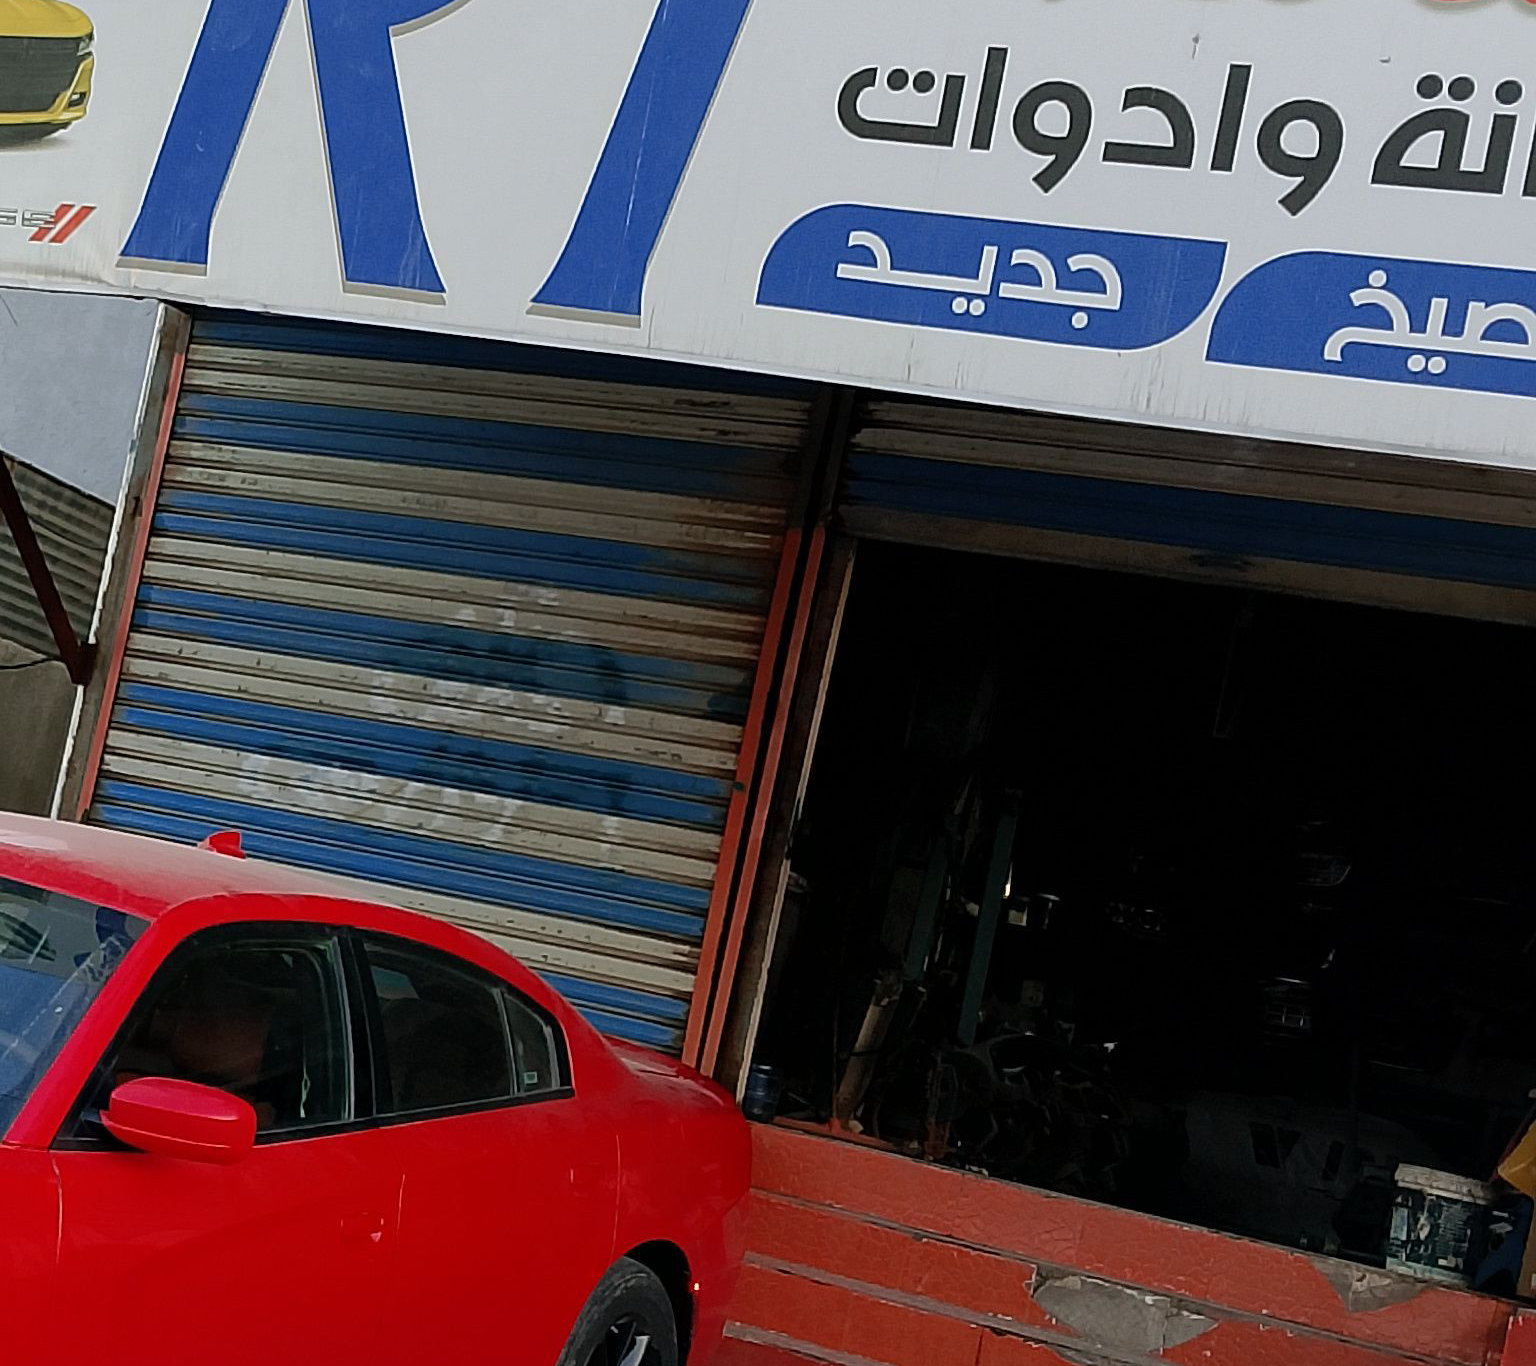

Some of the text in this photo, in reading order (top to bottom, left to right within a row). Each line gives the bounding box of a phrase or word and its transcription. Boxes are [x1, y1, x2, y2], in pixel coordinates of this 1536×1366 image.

[838, 46, 1344, 217] وادوات
[836, 231, 1536, 375] صيخ جديد
